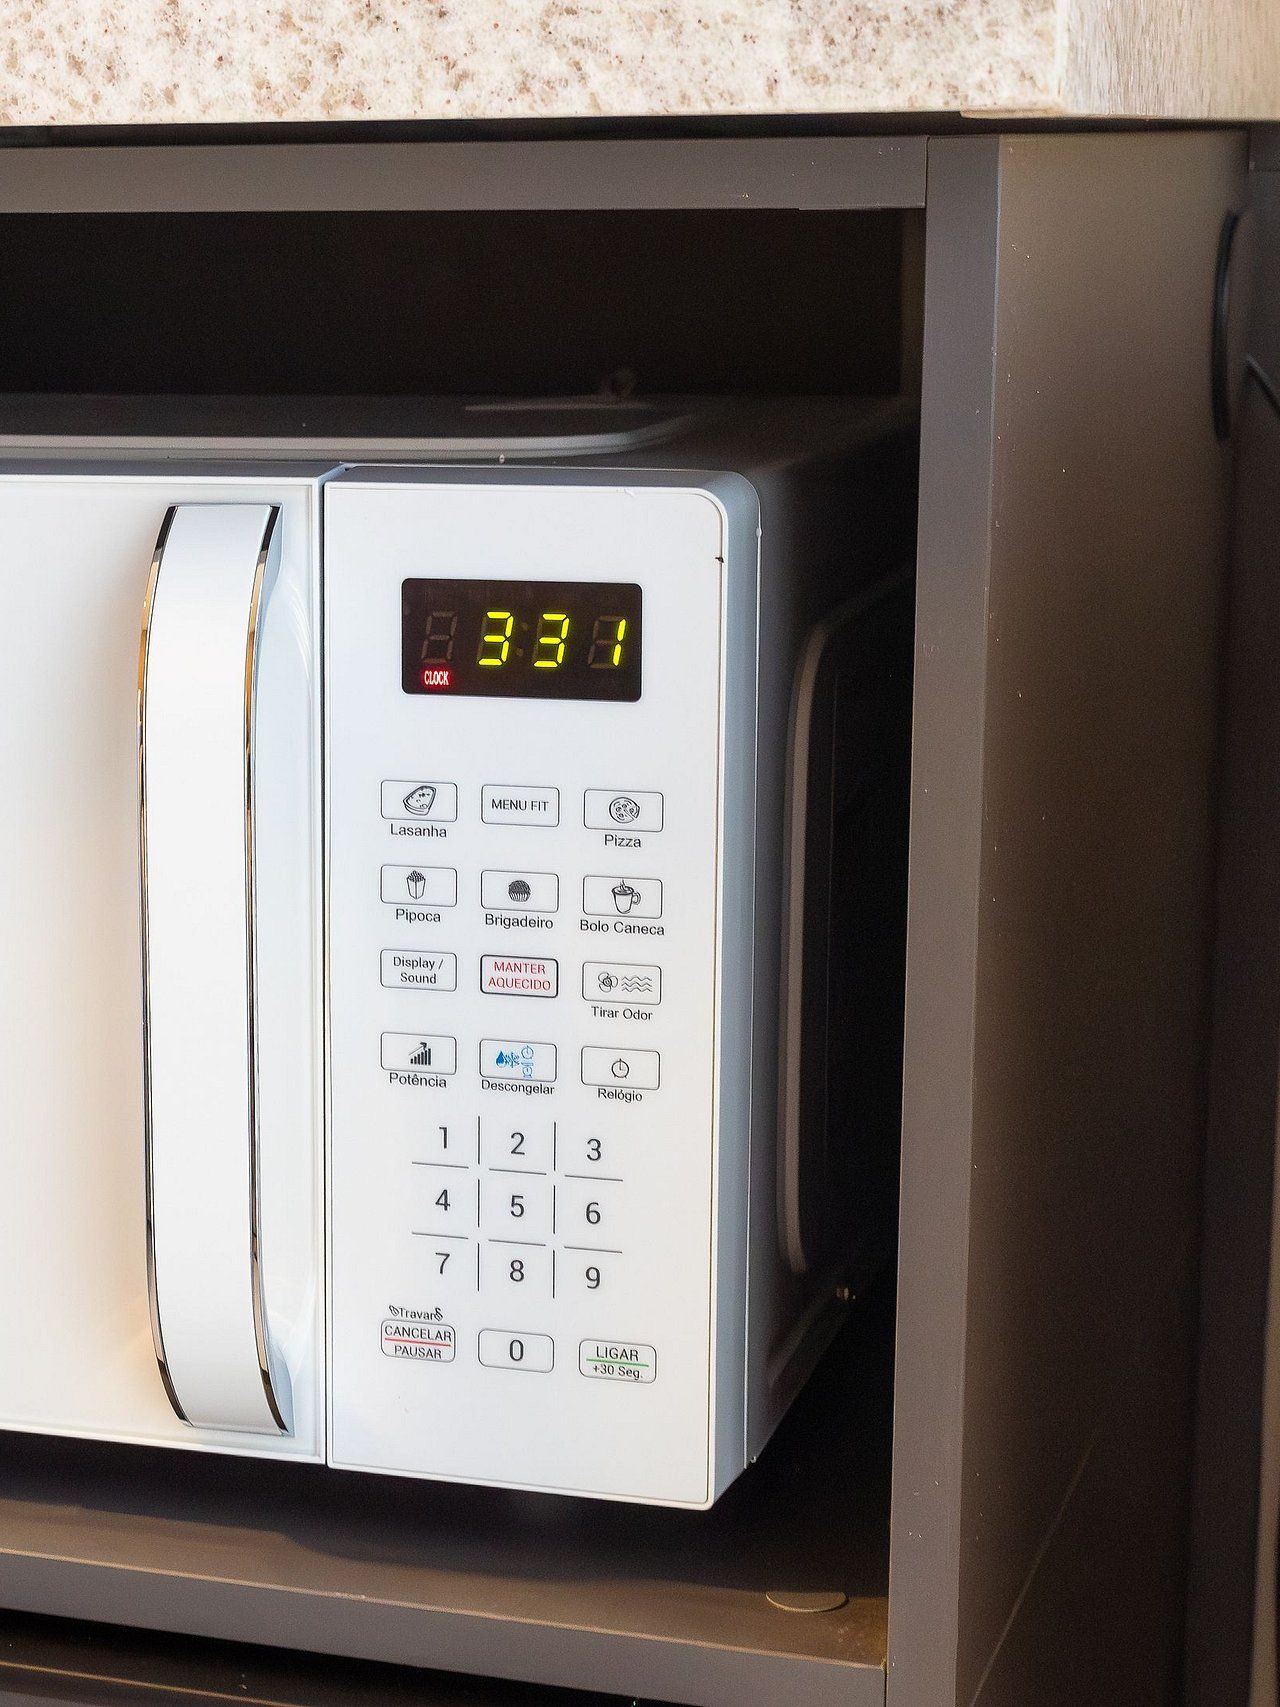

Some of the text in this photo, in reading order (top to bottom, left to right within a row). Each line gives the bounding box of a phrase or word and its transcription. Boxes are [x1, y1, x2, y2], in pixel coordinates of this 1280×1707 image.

[423, 671, 449, 686] CLOCK
[491, 799, 549, 813] MENU FIT
[390, 823, 447, 839] Lasanha
[604, 834, 642, 848] Pizza
[395, 908, 441, 924] Pipoca
[485, 913, 554, 930] Brigadeiro
[580, 919, 665, 936] Bolo Caneca
[393, 956, 435, 970] Display
[494, 961, 546, 975] MANTER
[400, 972, 437, 985] Sound
[488, 977, 551, 991] AQUECIDO
[591, 1005, 653, 1021] Tirar Odor
[389, 1072, 447, 1088] Potência
[481, 1079, 555, 1096] Descongelar
[597, 1087, 643, 1103] Relógio
[438, 1126, 448, 1150] 1
[509, 1132, 526, 1156] 2
[586, 1138, 602, 1161] 3
[435, 1189, 451, 1211] 4
[510, 1195, 525, 1218] 5
[585, 1201, 601, 1225] 6
[435, 1252, 450, 1275] 7
[509, 1259, 525, 1283] 8
[585, 1266, 601, 1290] 9
[399, 1307, 436, 1321] Travar
[384, 1325, 452, 1342] CANCELAR
[394, 1344, 442, 1359] PAUSAR
[509, 1339, 524, 1362] 0
[596, 1346, 639, 1362] LIGAR
[592, 1363, 643, 1380] +30 Seg.
